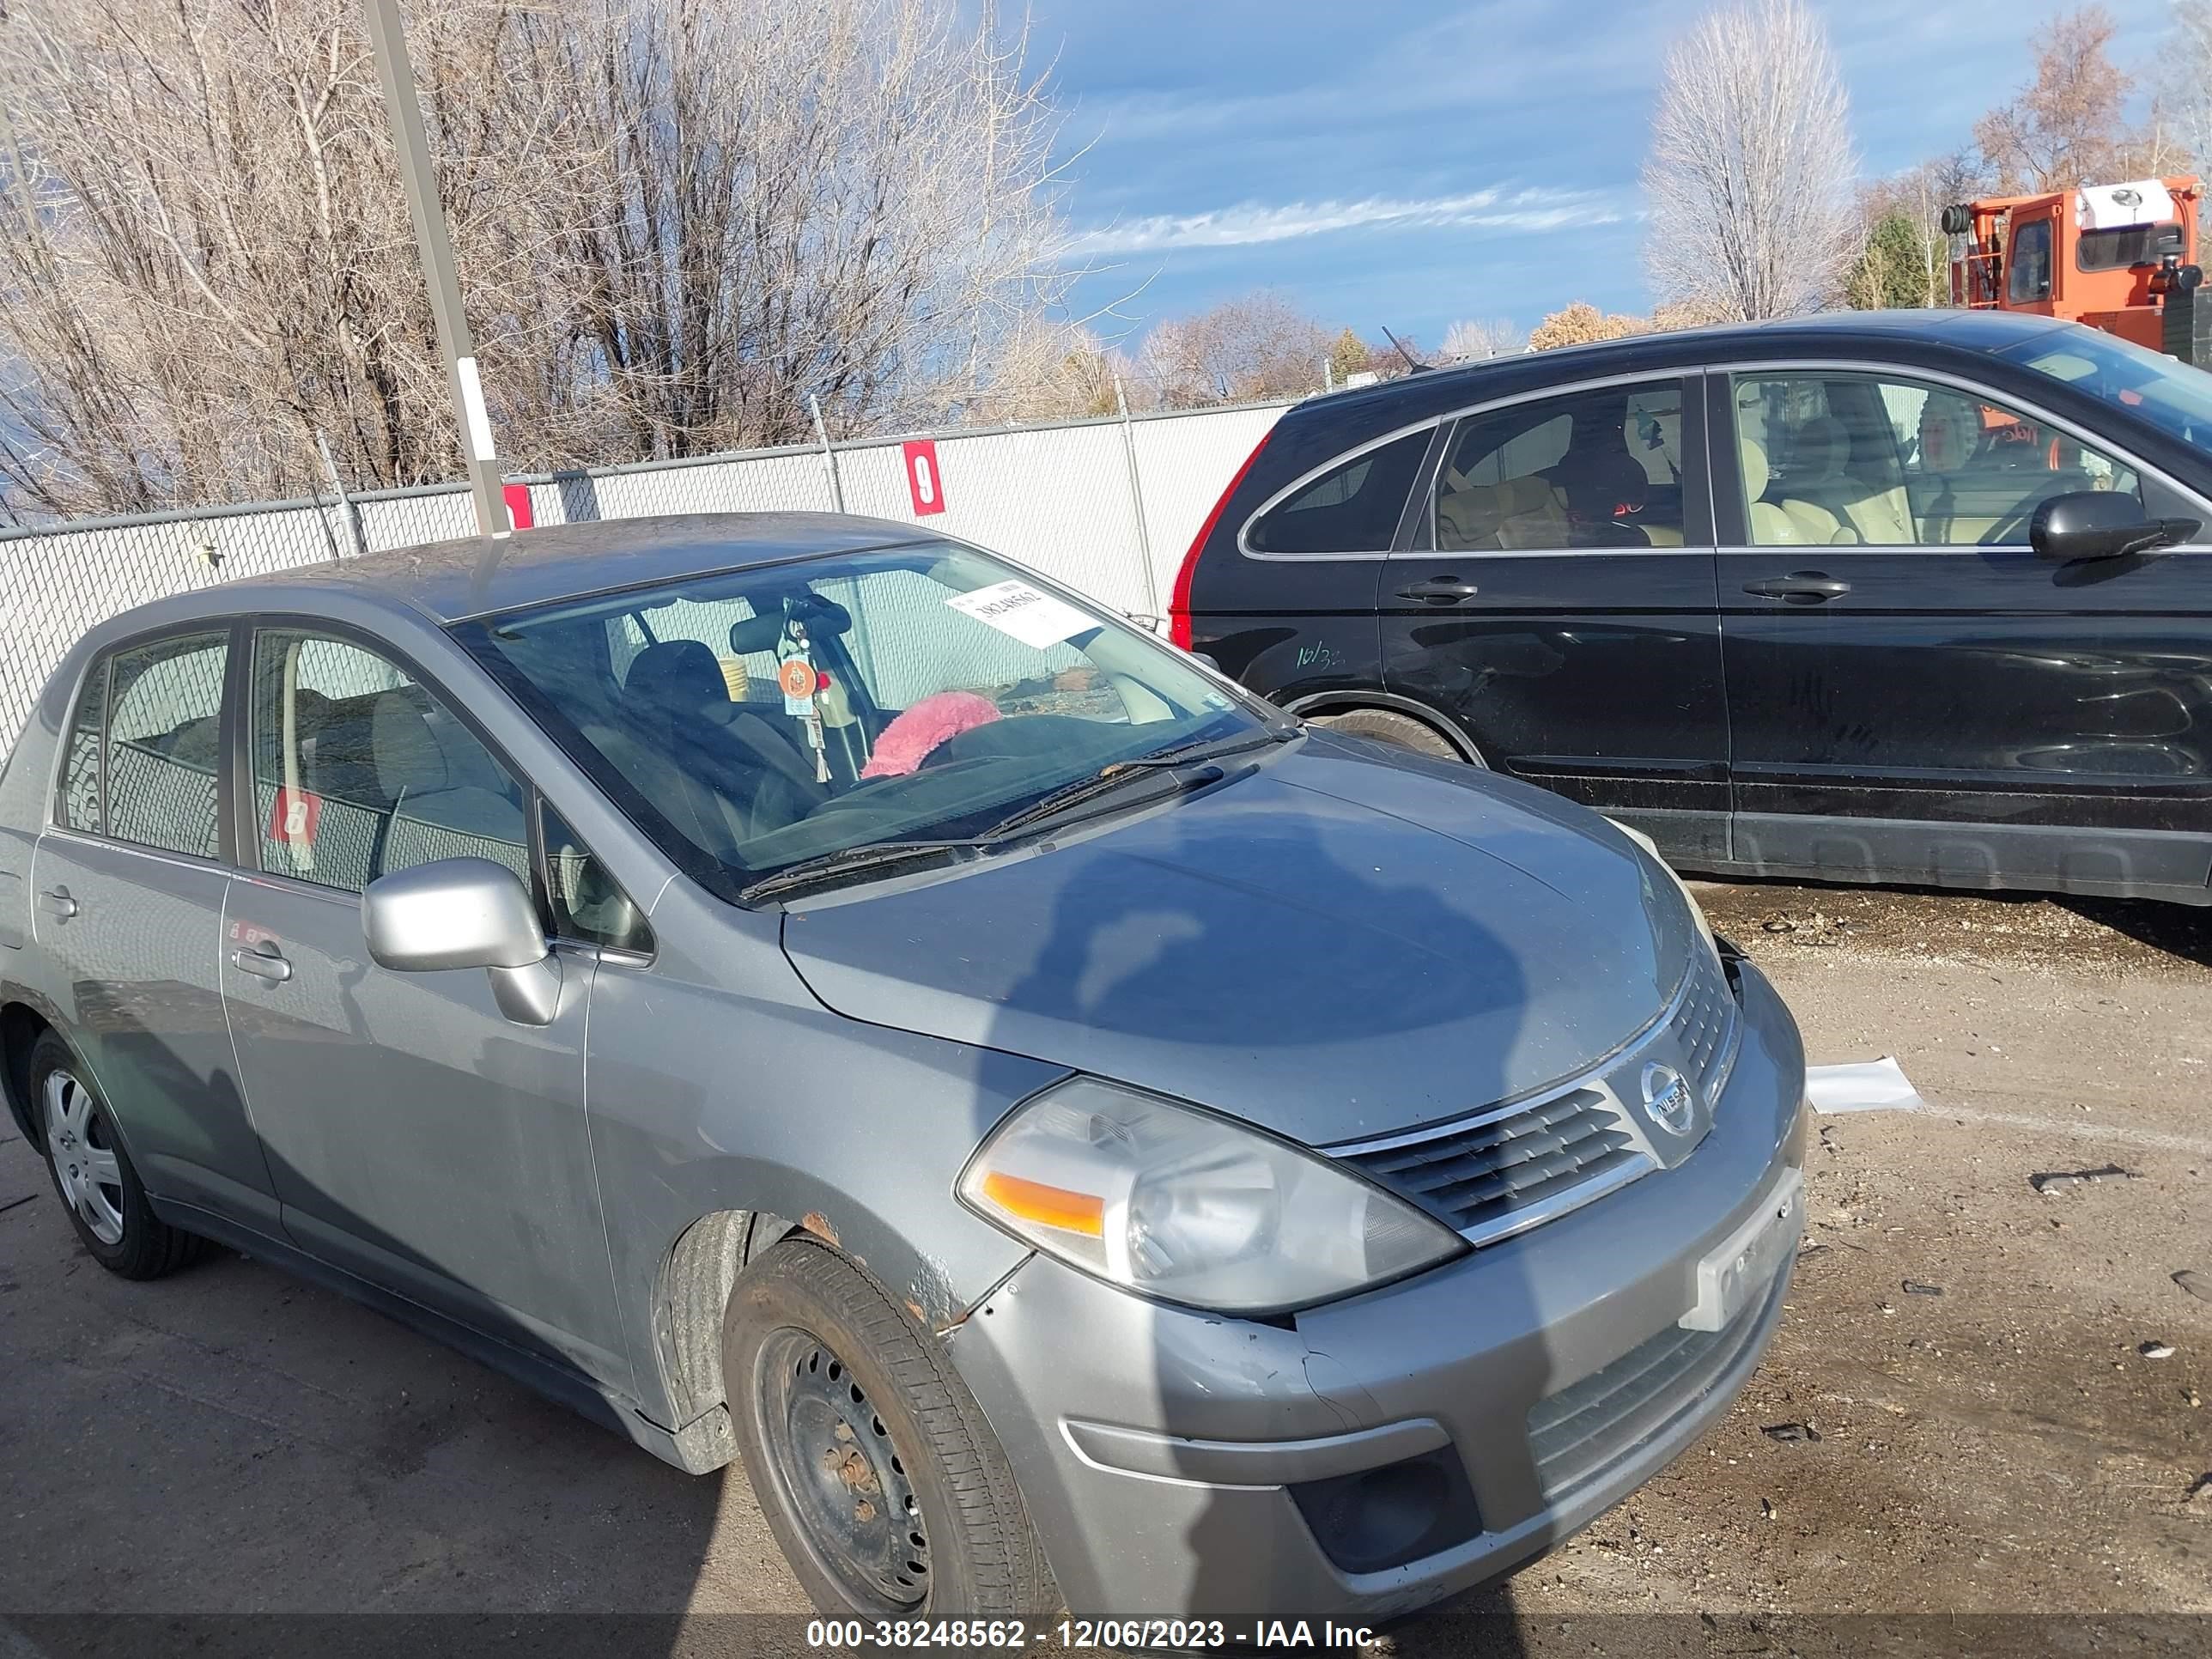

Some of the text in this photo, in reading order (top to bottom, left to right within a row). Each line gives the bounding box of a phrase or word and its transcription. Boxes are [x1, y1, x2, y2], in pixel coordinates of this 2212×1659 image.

[915, 453, 934, 505] 9
[975, 592, 1042, 617] 38248562
[1656, 1078, 1689, 1115] NISSAN
